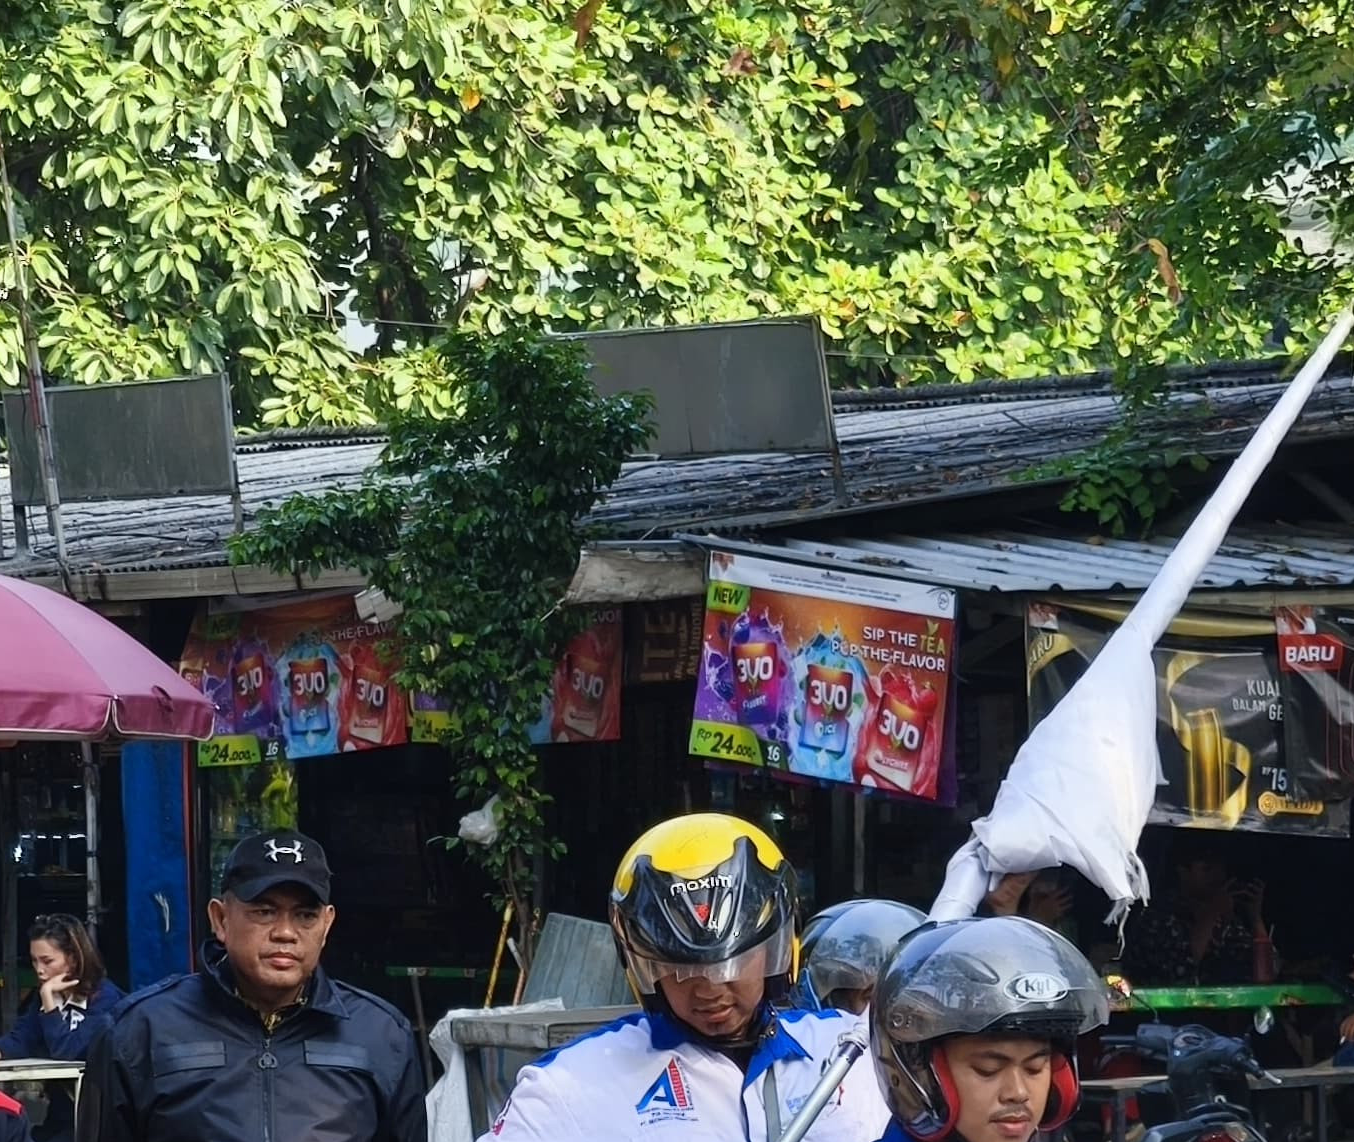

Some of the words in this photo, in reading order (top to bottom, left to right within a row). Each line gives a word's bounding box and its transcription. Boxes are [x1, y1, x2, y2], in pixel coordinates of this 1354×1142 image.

[713, 586, 743, 605] NEW
[863, 626, 886, 642] SIP
[888, 630, 918, 647] THE
[920, 636, 946, 655] TEA
[861, 644, 890, 661] THE
[892, 650, 946, 673] FLAVOR
[1285, 645, 1336, 664] BARU
[1232, 698, 1266, 713] DALAM
[265, 741, 279, 758] 16
[767, 745, 781, 763] 16
[669, 874, 733, 897] maxim
